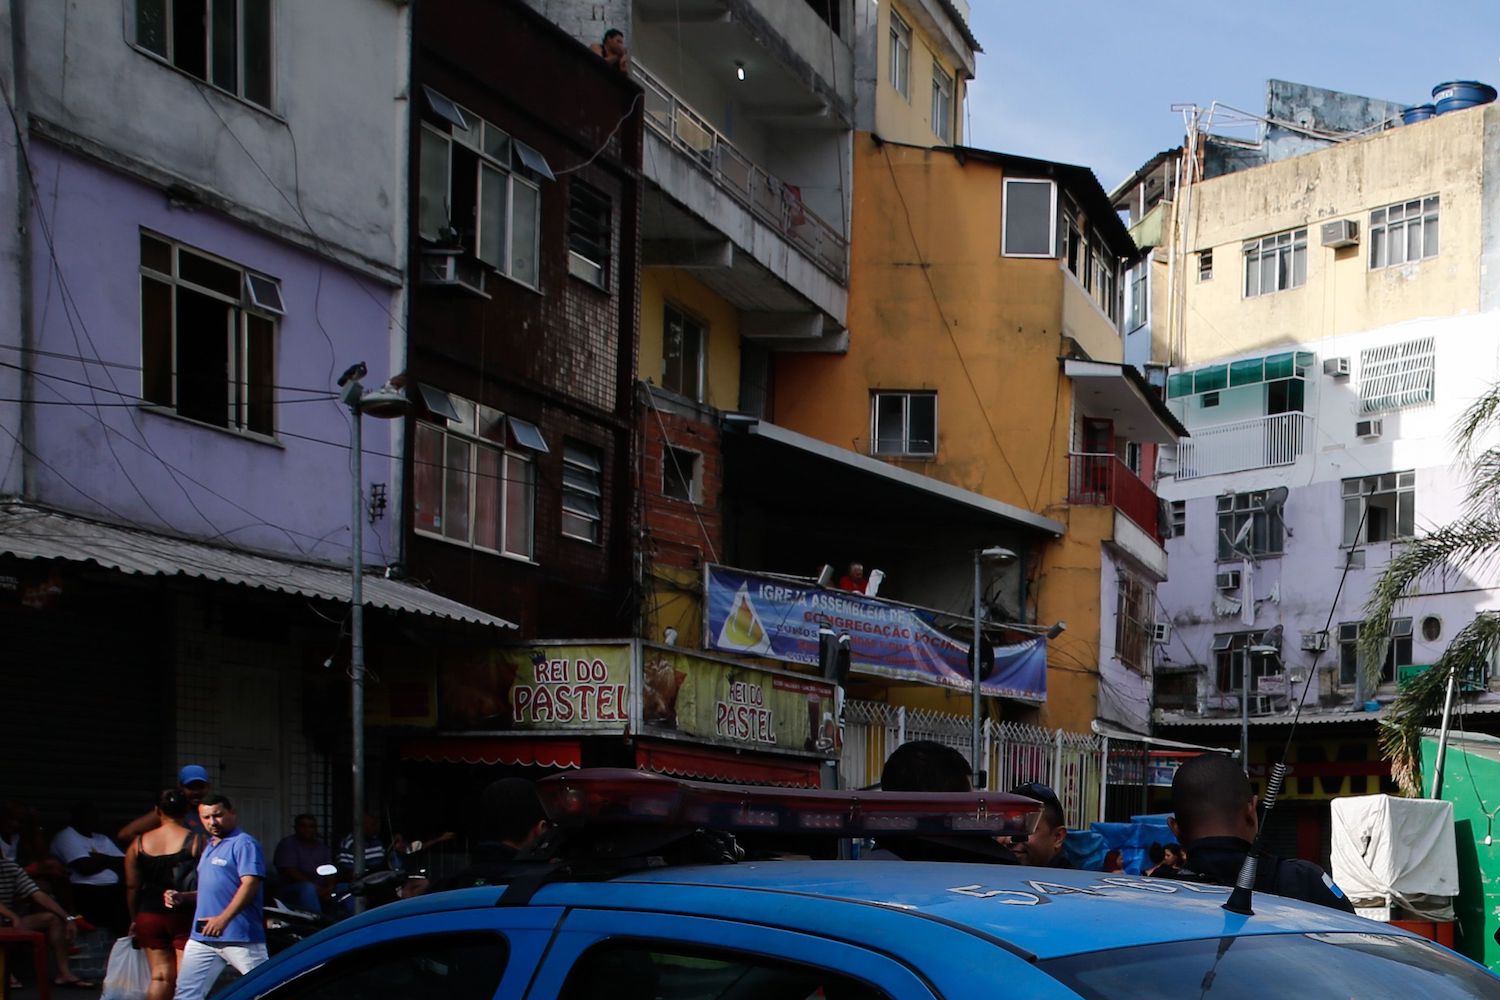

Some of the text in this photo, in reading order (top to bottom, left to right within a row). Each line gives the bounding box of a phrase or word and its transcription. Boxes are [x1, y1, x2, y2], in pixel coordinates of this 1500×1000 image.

[811, 593, 886, 621] ASSEMBLEIA
[533, 659, 608, 684] REI DO
[512, 685, 629, 723] PASTEL
[716, 702, 776, 745] PASTEL
